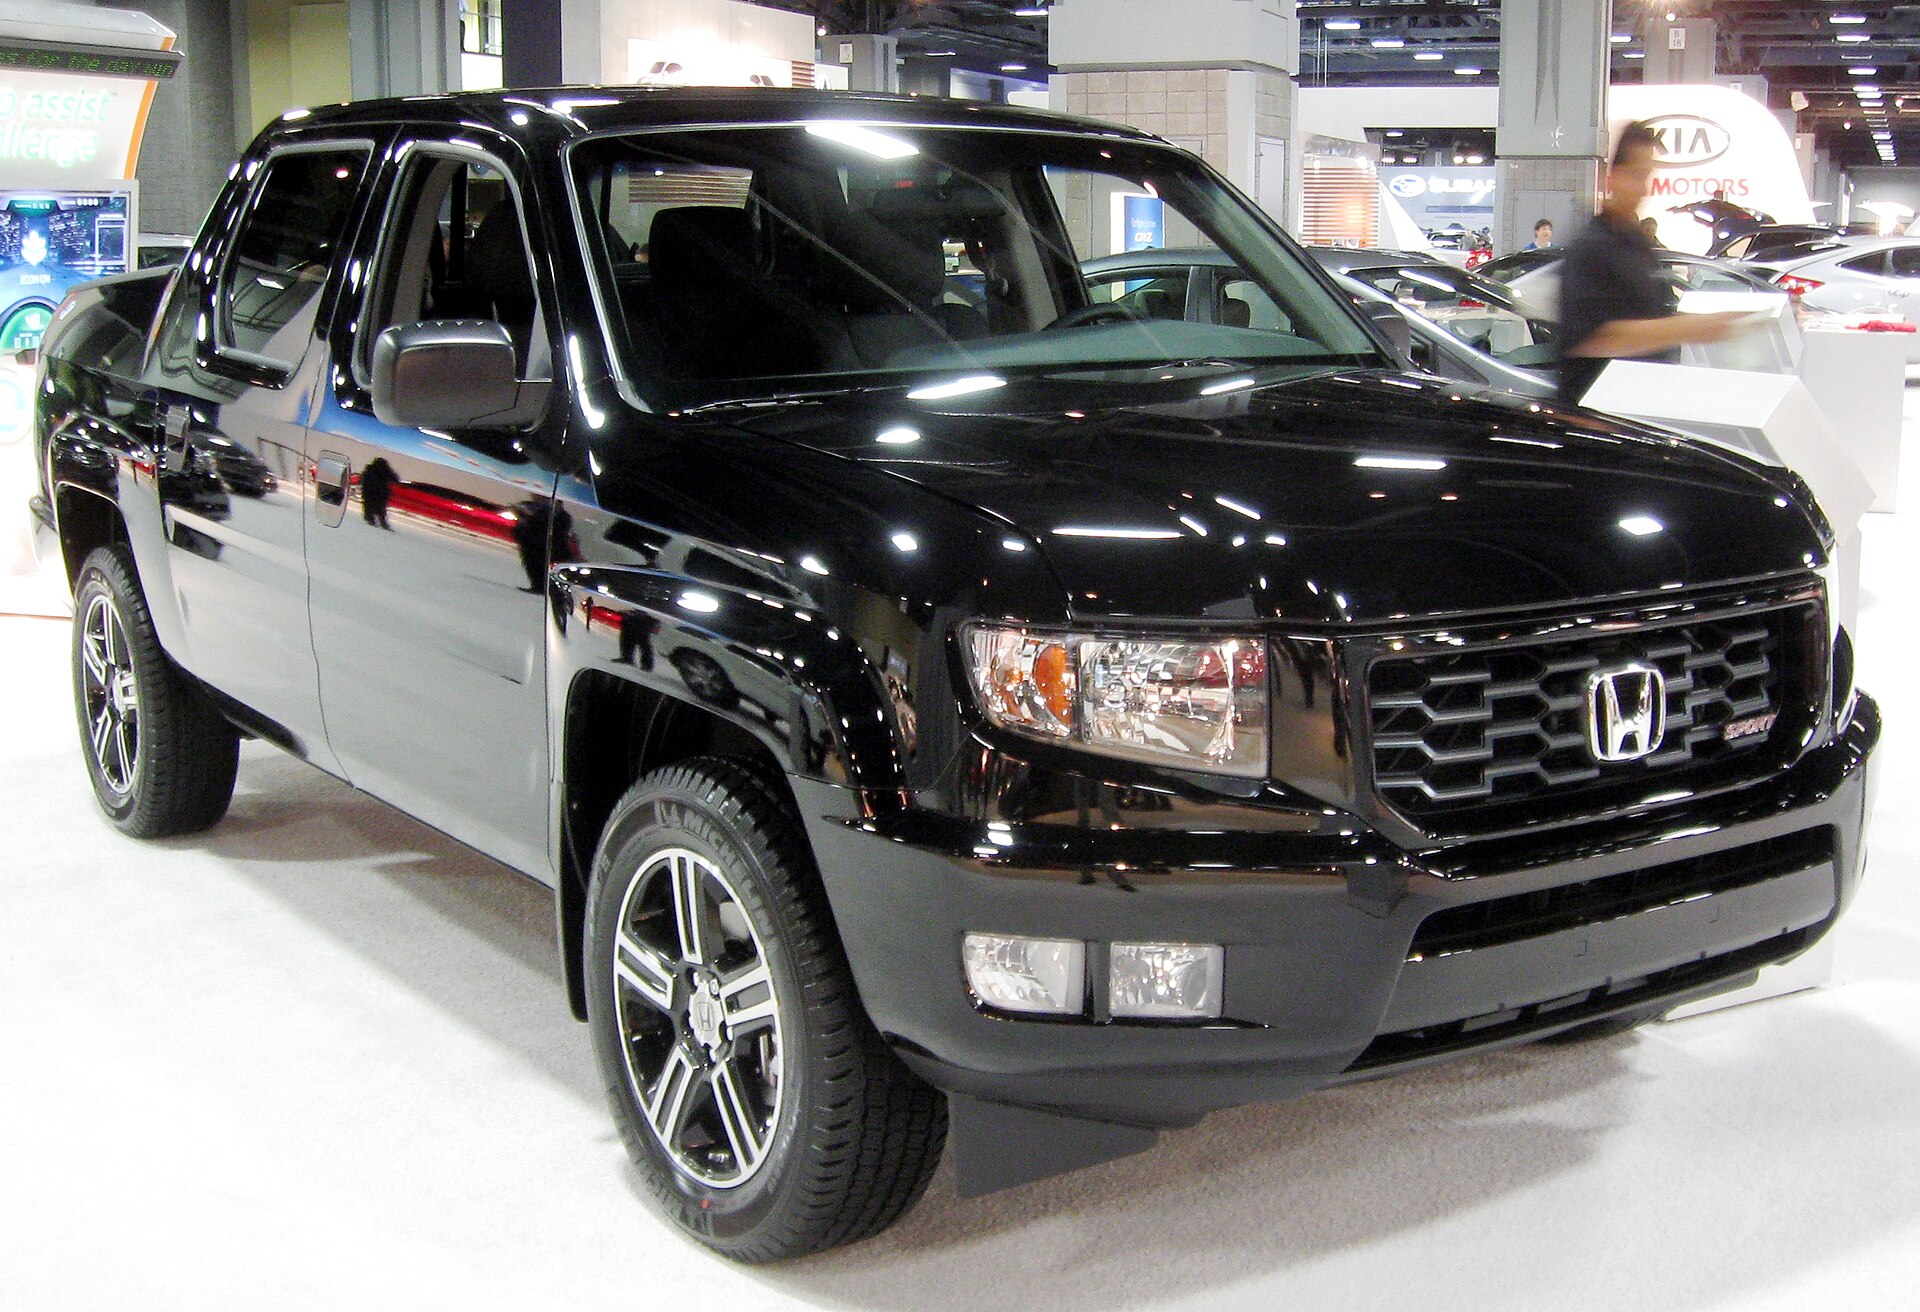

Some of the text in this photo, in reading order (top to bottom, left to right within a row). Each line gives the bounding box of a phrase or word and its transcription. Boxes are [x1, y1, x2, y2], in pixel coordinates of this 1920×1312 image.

[24, 87, 112, 121] assist
[1645, 127, 1713, 155] KIA
[1650, 177, 1749, 197] MOTORS
[1725, 714, 1777, 740] SPORT
